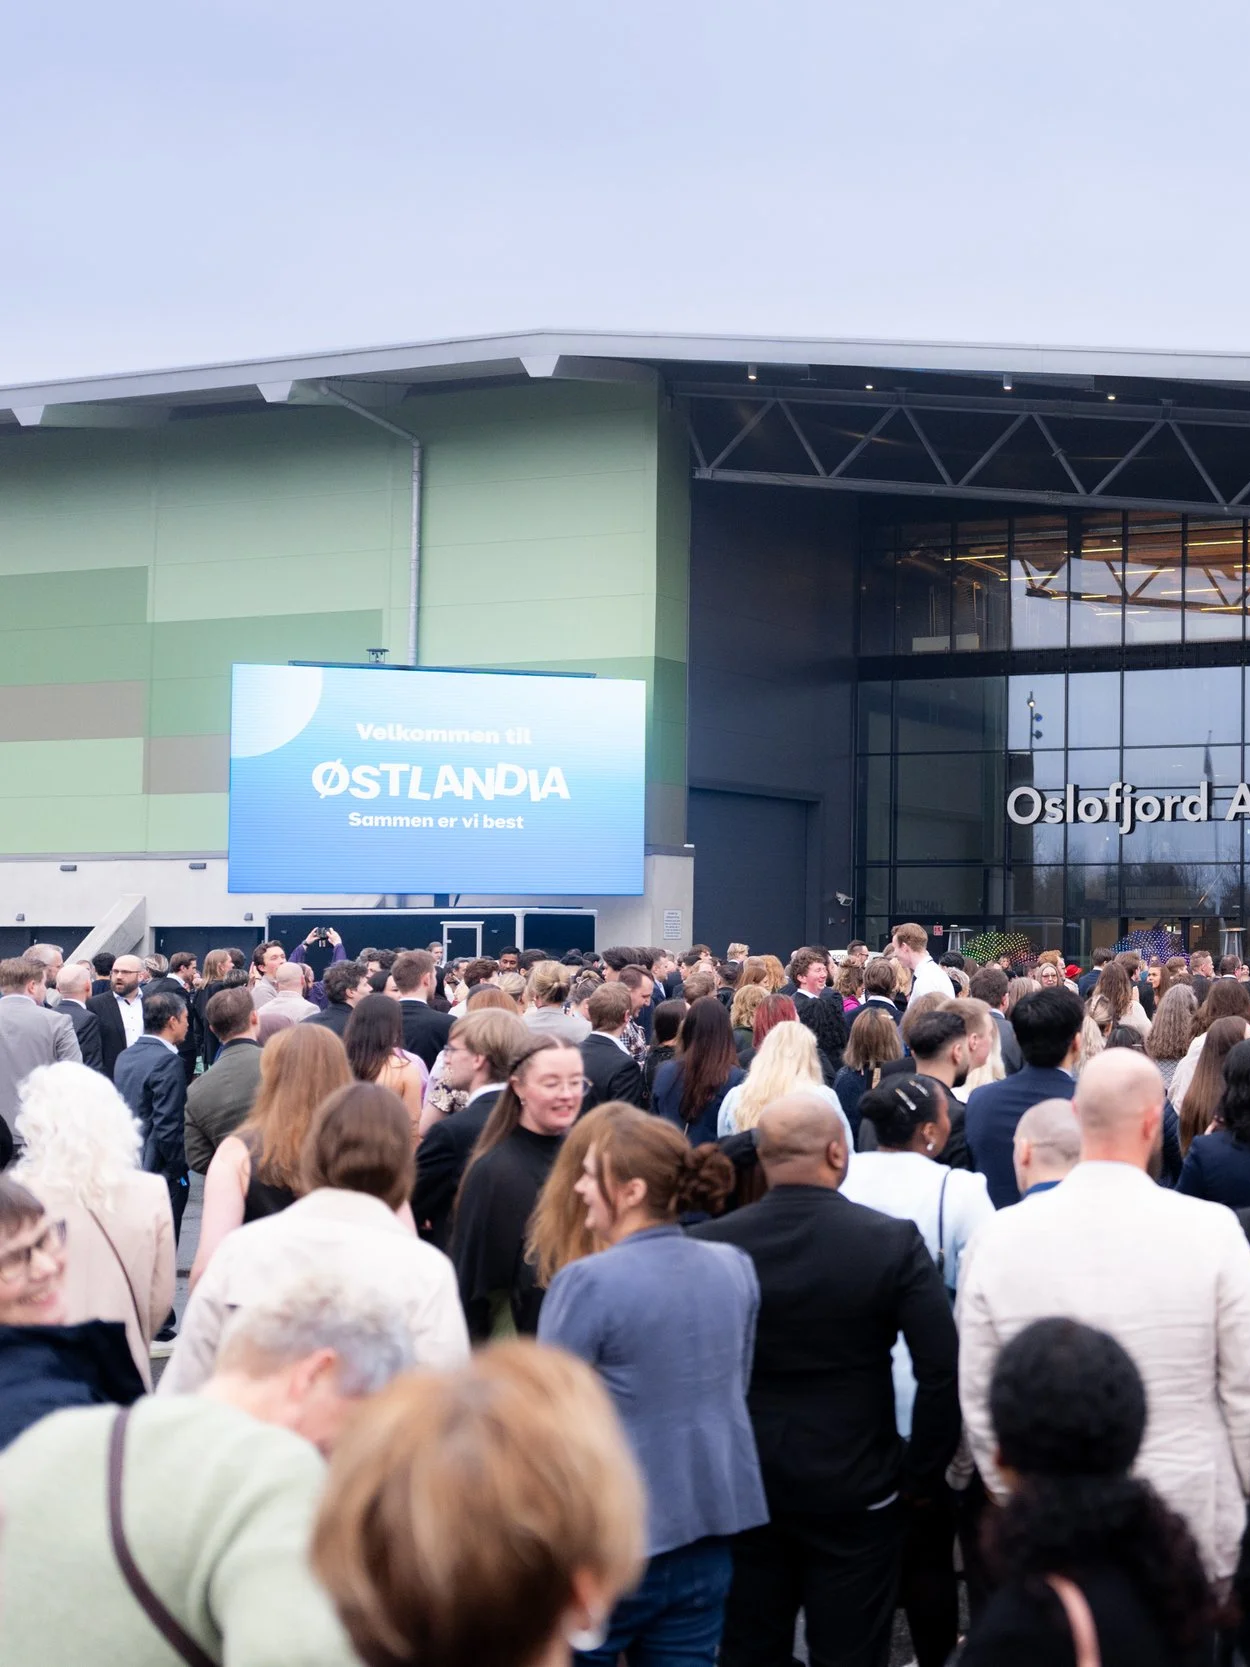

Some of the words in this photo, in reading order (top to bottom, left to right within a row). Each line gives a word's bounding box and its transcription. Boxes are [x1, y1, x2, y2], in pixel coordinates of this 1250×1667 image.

[356, 723, 500, 744] Velkommen
[505, 727, 532, 745] til
[311, 758, 571, 802] ØSTLANDIA
[348, 812, 434, 828] Sammen
[437, 816, 458, 828] er
[462, 814, 479, 829] vi
[483, 814, 524, 829] best
[1006, 781, 1212, 835] Oslofjord
